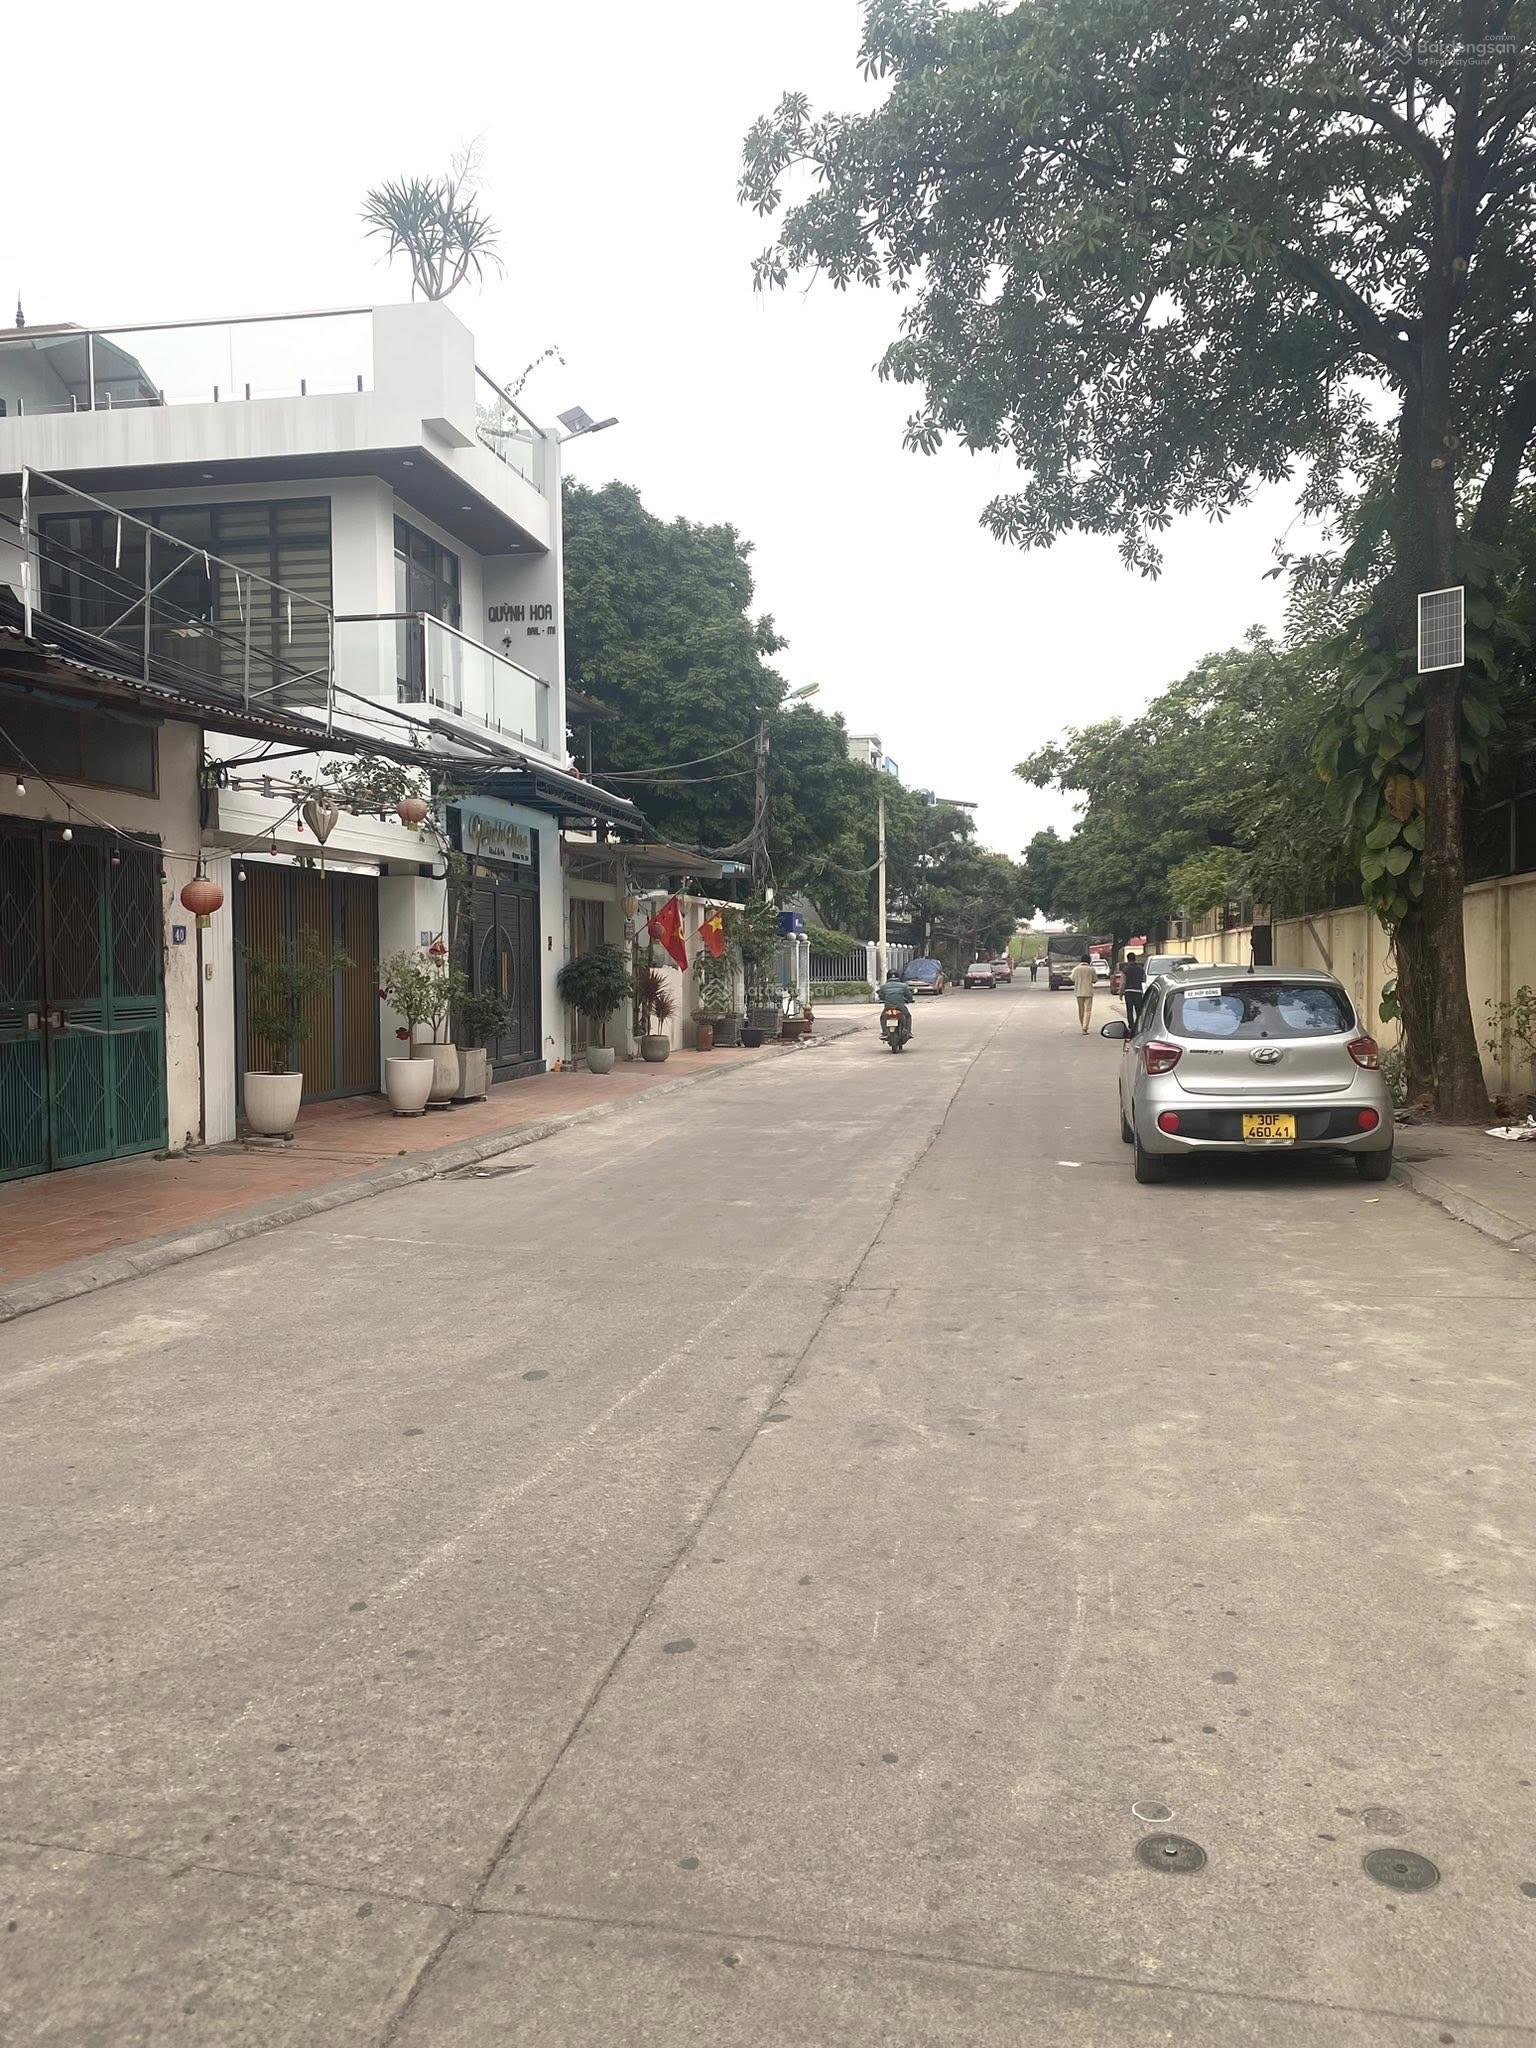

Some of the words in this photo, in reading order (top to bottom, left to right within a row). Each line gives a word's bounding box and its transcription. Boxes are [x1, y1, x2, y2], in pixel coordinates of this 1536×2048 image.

[488, 603, 524, 623] QUỲNH
[530, 604, 552, 621] HOA
[175, 928, 185, 941] 40
[1257, 1115, 1280, 1126] 30F
[1248, 1127, 1289, 1139] 460.41
